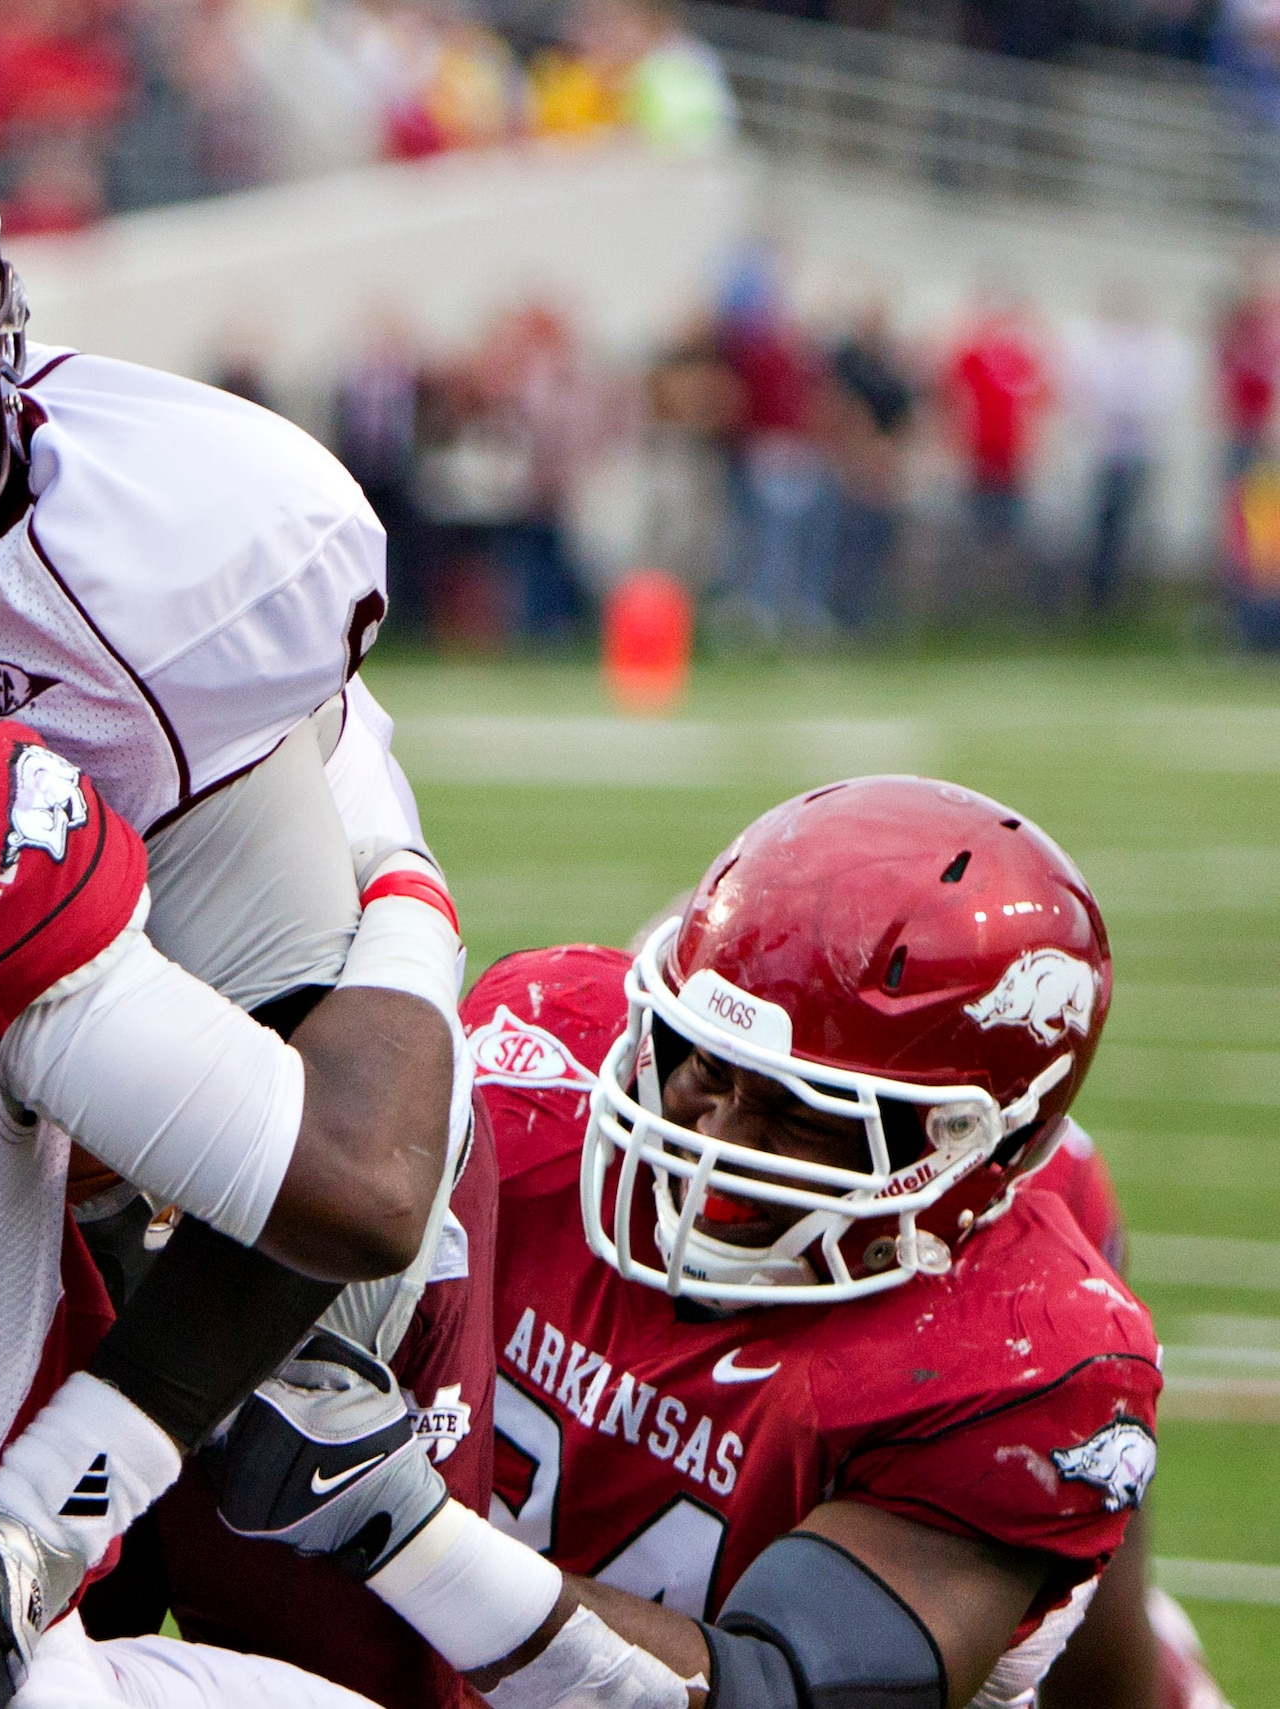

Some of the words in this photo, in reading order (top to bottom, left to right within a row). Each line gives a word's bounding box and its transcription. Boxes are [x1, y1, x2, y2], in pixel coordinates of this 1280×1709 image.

[708, 987, 756, 1030] HOGS
[494, 1036, 545, 1073] SEC
[504, 1307, 744, 1496] ARKANSAS
